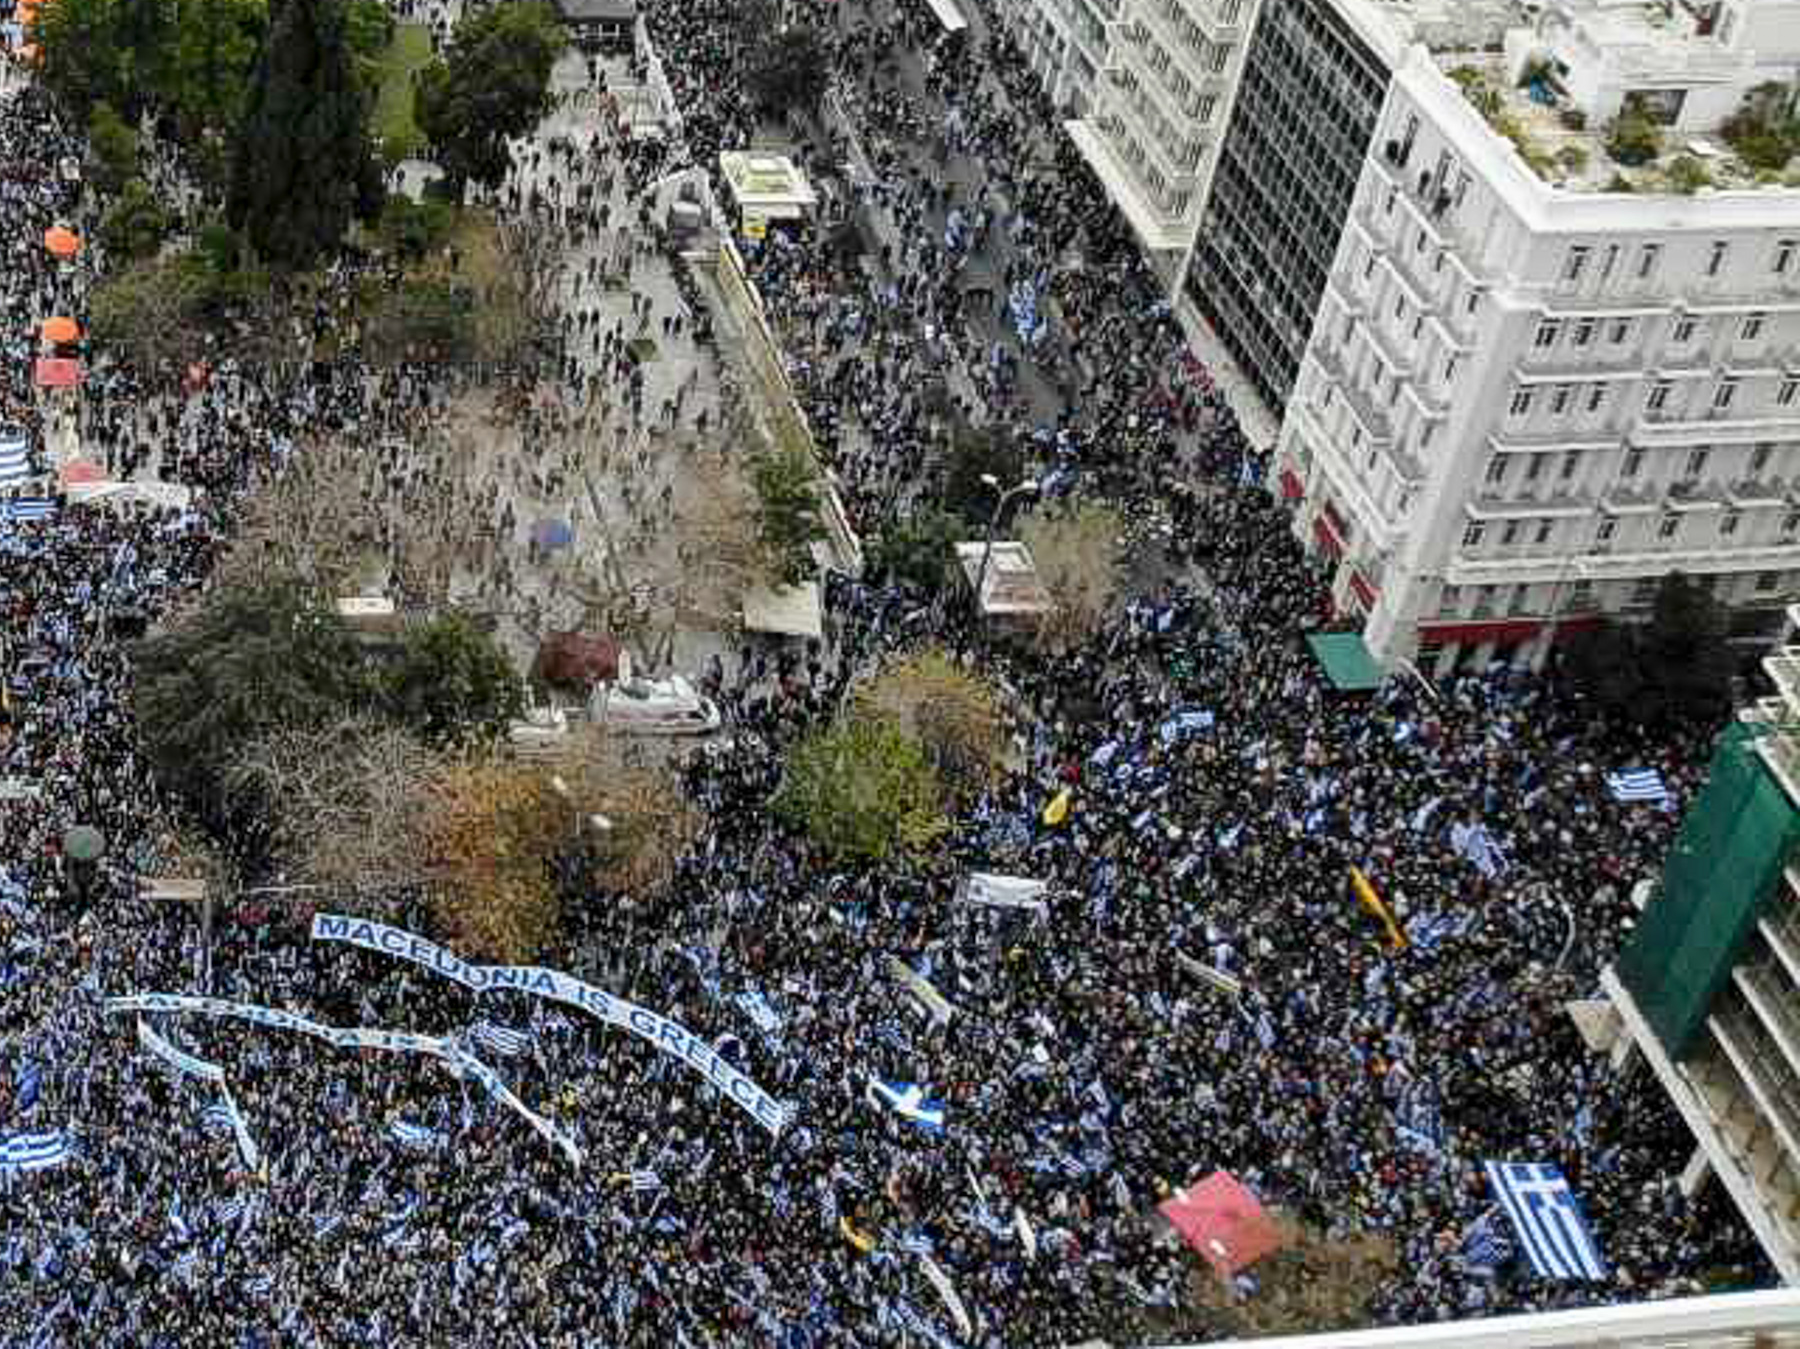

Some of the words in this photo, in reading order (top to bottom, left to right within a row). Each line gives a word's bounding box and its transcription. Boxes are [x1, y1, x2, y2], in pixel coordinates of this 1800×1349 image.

[318, 917, 558, 994] MACEDONIA
[577, 984, 611, 1015] IS
[629, 1009, 781, 1129] GREECE
